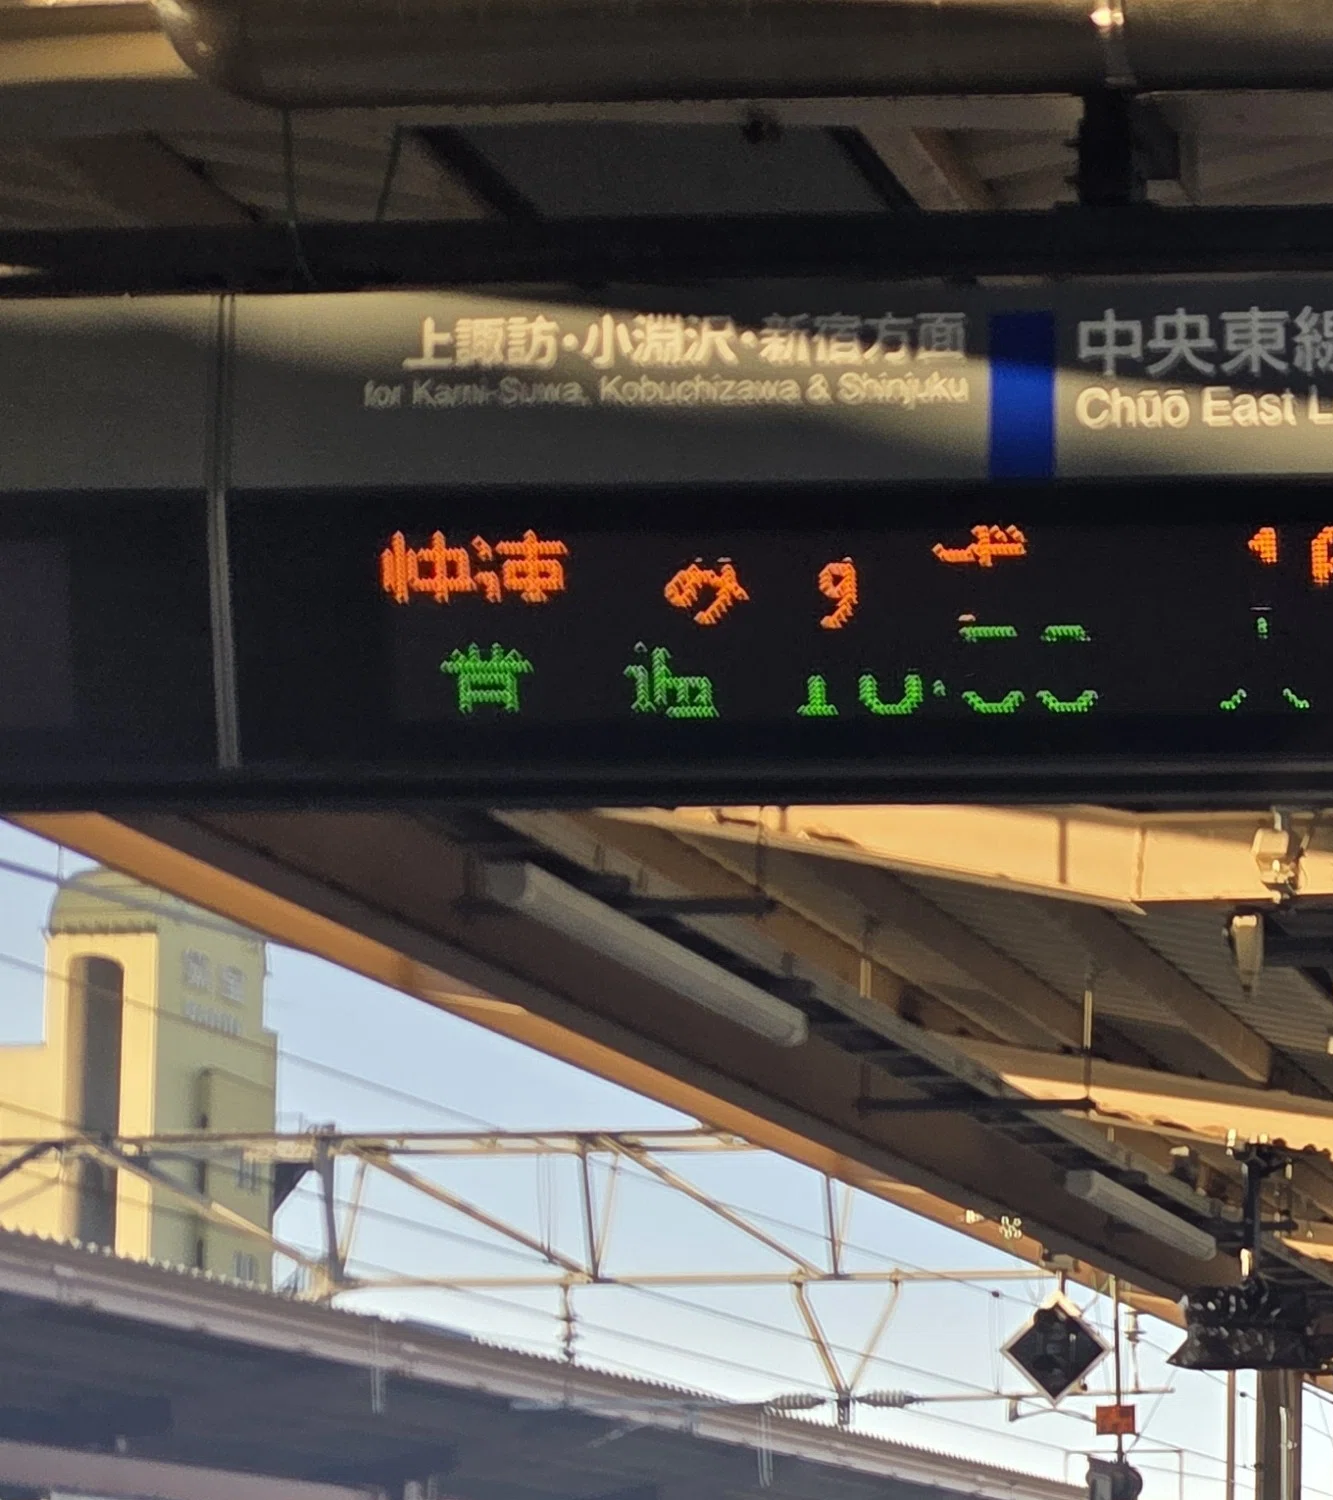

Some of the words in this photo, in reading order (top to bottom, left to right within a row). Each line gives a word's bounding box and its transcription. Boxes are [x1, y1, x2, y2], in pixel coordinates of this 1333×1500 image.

[364, 379, 403, 407] for
[600, 373, 802, 408] Kobuchizawa
[805, 372, 833, 403] &
[838, 370, 970, 410] Shinjuku
[1075, 386, 1190, 430] Chūō
[1201, 384, 1298, 428] East
